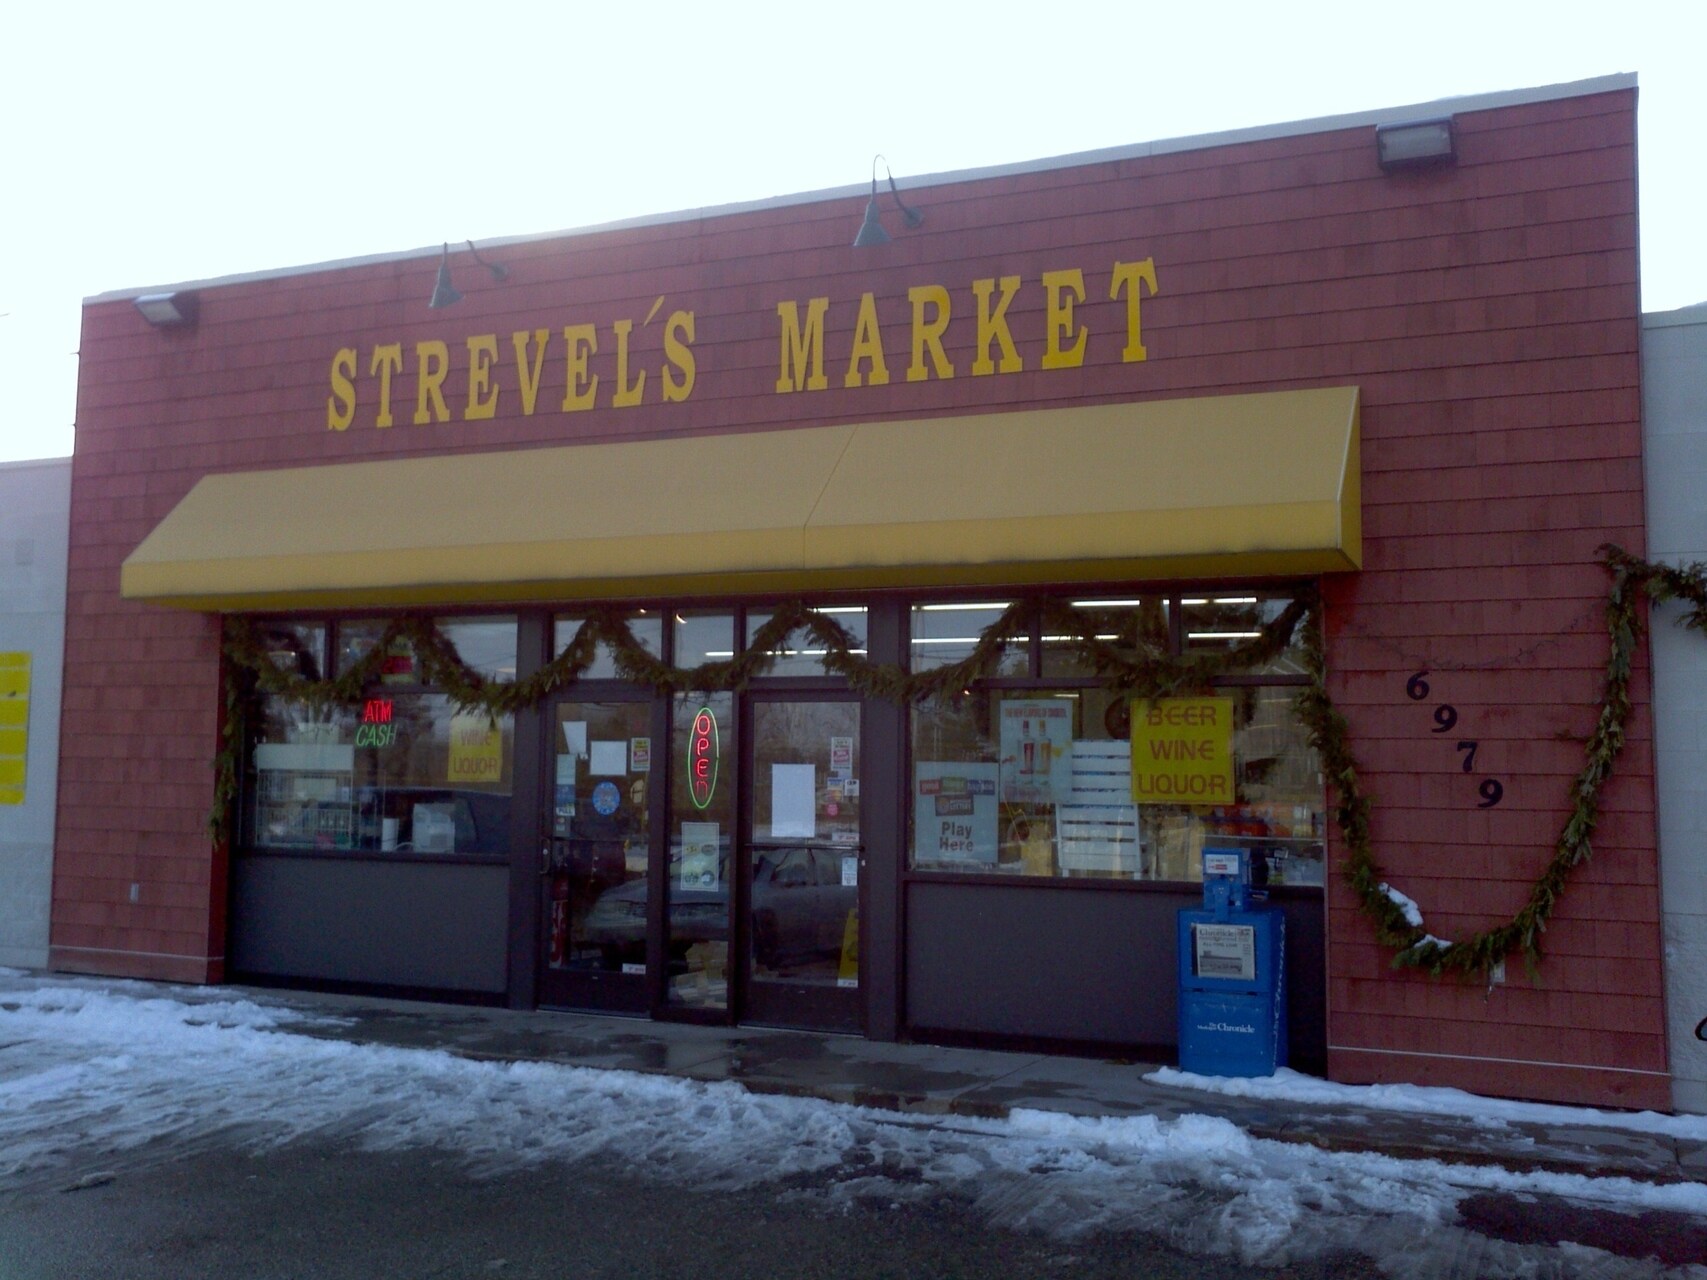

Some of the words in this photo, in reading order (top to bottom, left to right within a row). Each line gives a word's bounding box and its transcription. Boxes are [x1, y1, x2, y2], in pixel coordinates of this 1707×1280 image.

[776, 256, 1159, 393] MARKET
[363, 701, 392, 722] ATM
[1146, 705, 1217, 726] BEER
[356, 725, 398, 746] CASH
[1148, 739, 1216, 760] WINE
[452, 757, 498, 774] LIQUOR
[1137, 773, 1227, 795] LIQUOR
[941, 821, 973, 839] Play
[939, 836, 975, 852] Here
[1217, 1022, 1256, 1034] Chronicle
